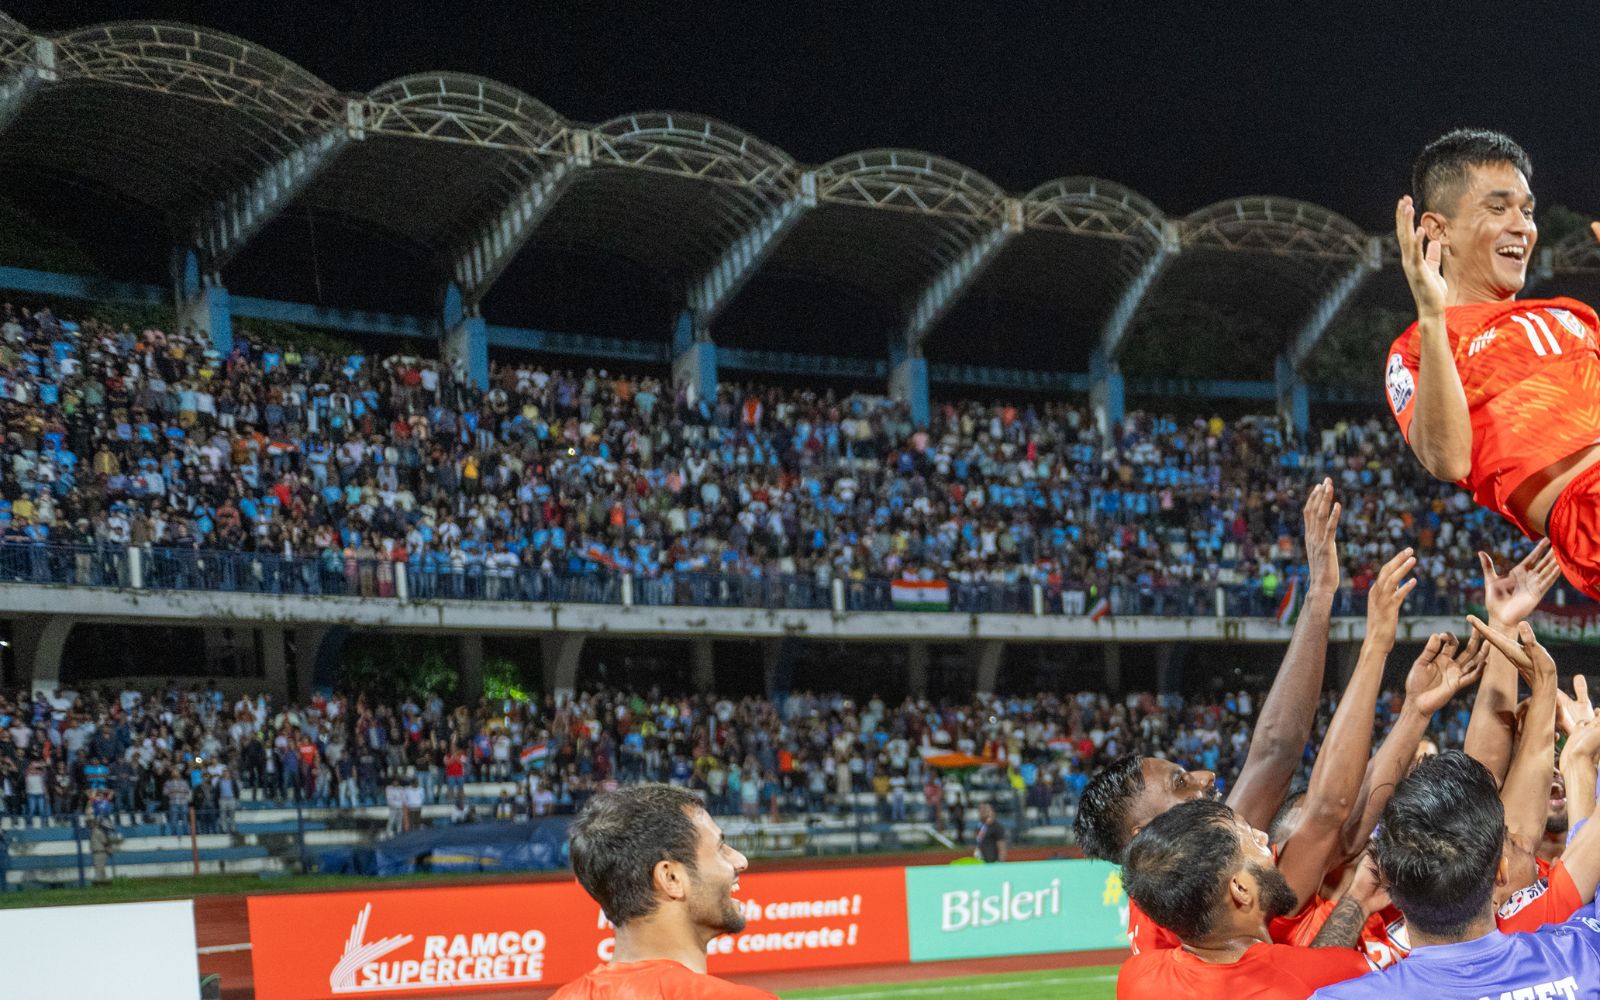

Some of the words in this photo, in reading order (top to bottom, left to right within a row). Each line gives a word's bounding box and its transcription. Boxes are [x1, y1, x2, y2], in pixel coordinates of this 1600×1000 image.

[1511, 311, 1563, 357] 11
[765, 896, 849, 920] cement
[941, 878, 1061, 931] Bisleri
[422, 930, 546, 959] RAMCO
[737, 927, 846, 953] concrete
[360, 952, 545, 987] SUPERCRETE
